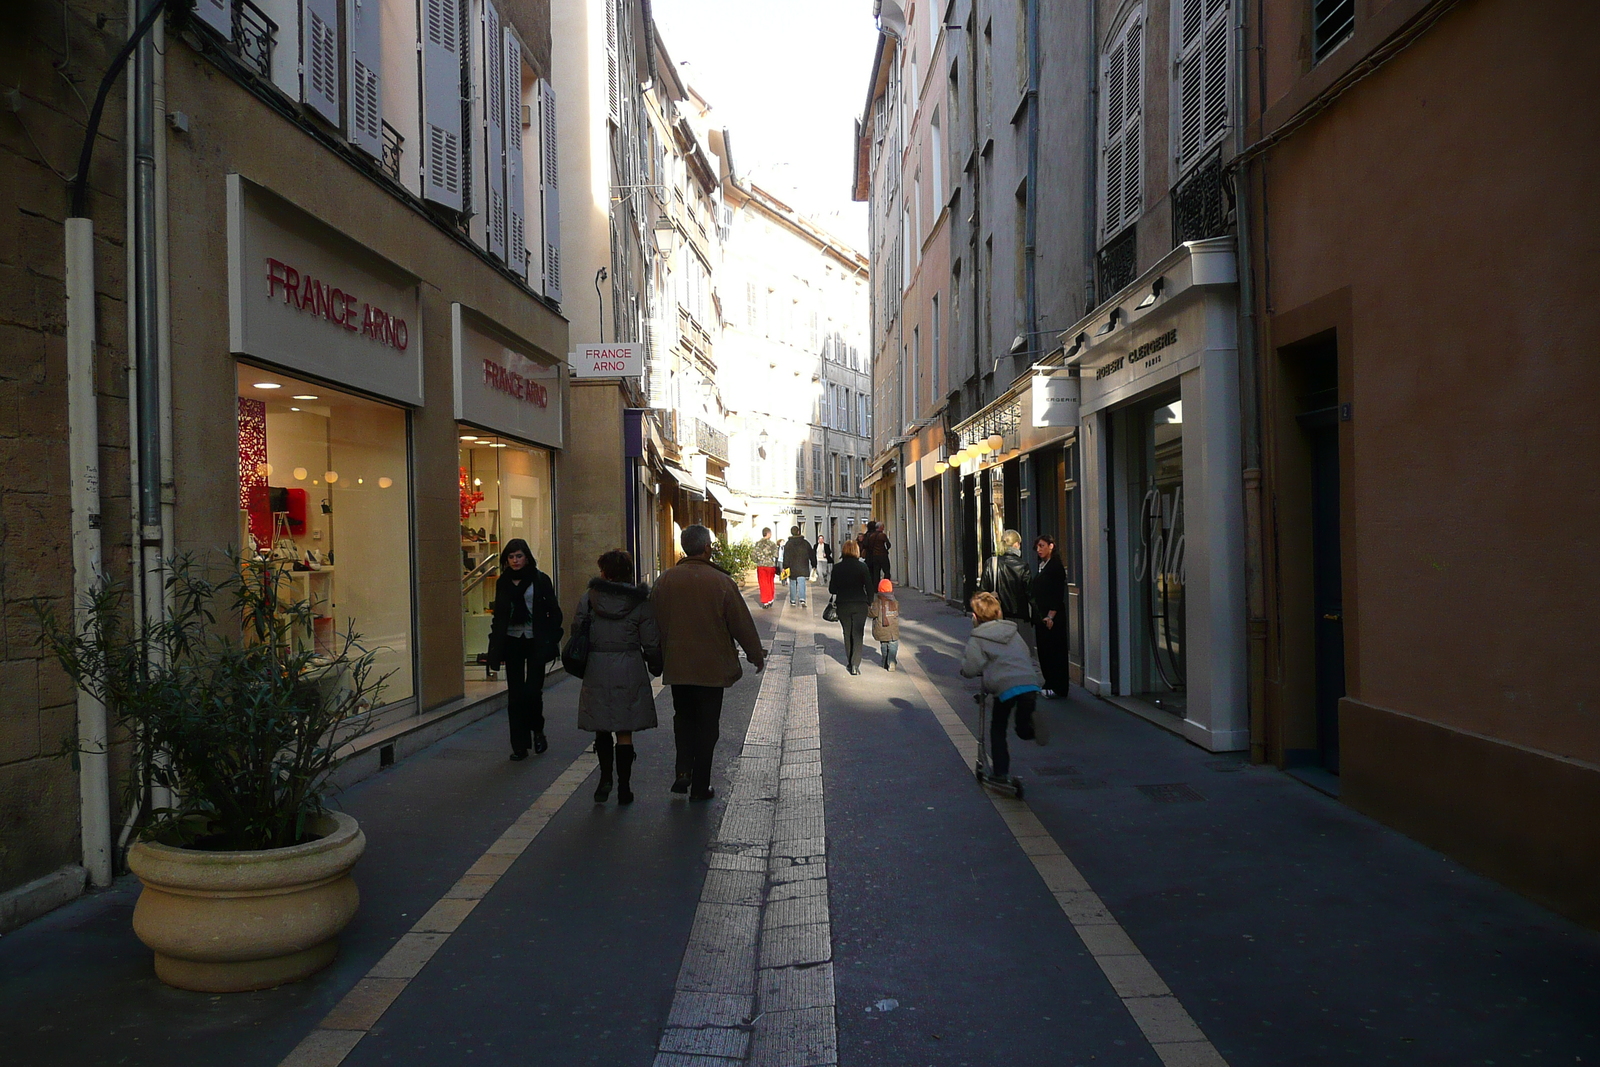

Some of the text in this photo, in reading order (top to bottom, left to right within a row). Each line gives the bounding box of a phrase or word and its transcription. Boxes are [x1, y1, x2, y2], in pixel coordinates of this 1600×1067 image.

[267, 258, 408, 351] FRANCE ARNO
[585, 349, 632, 359] FRANCE
[593, 361, 625, 371] ARNO
[1096, 328, 1177, 381] ROBERT CLERGERIE
[1145, 355, 1162, 369] PARIS
[483, 358, 548, 409] FRANCE ARNO
